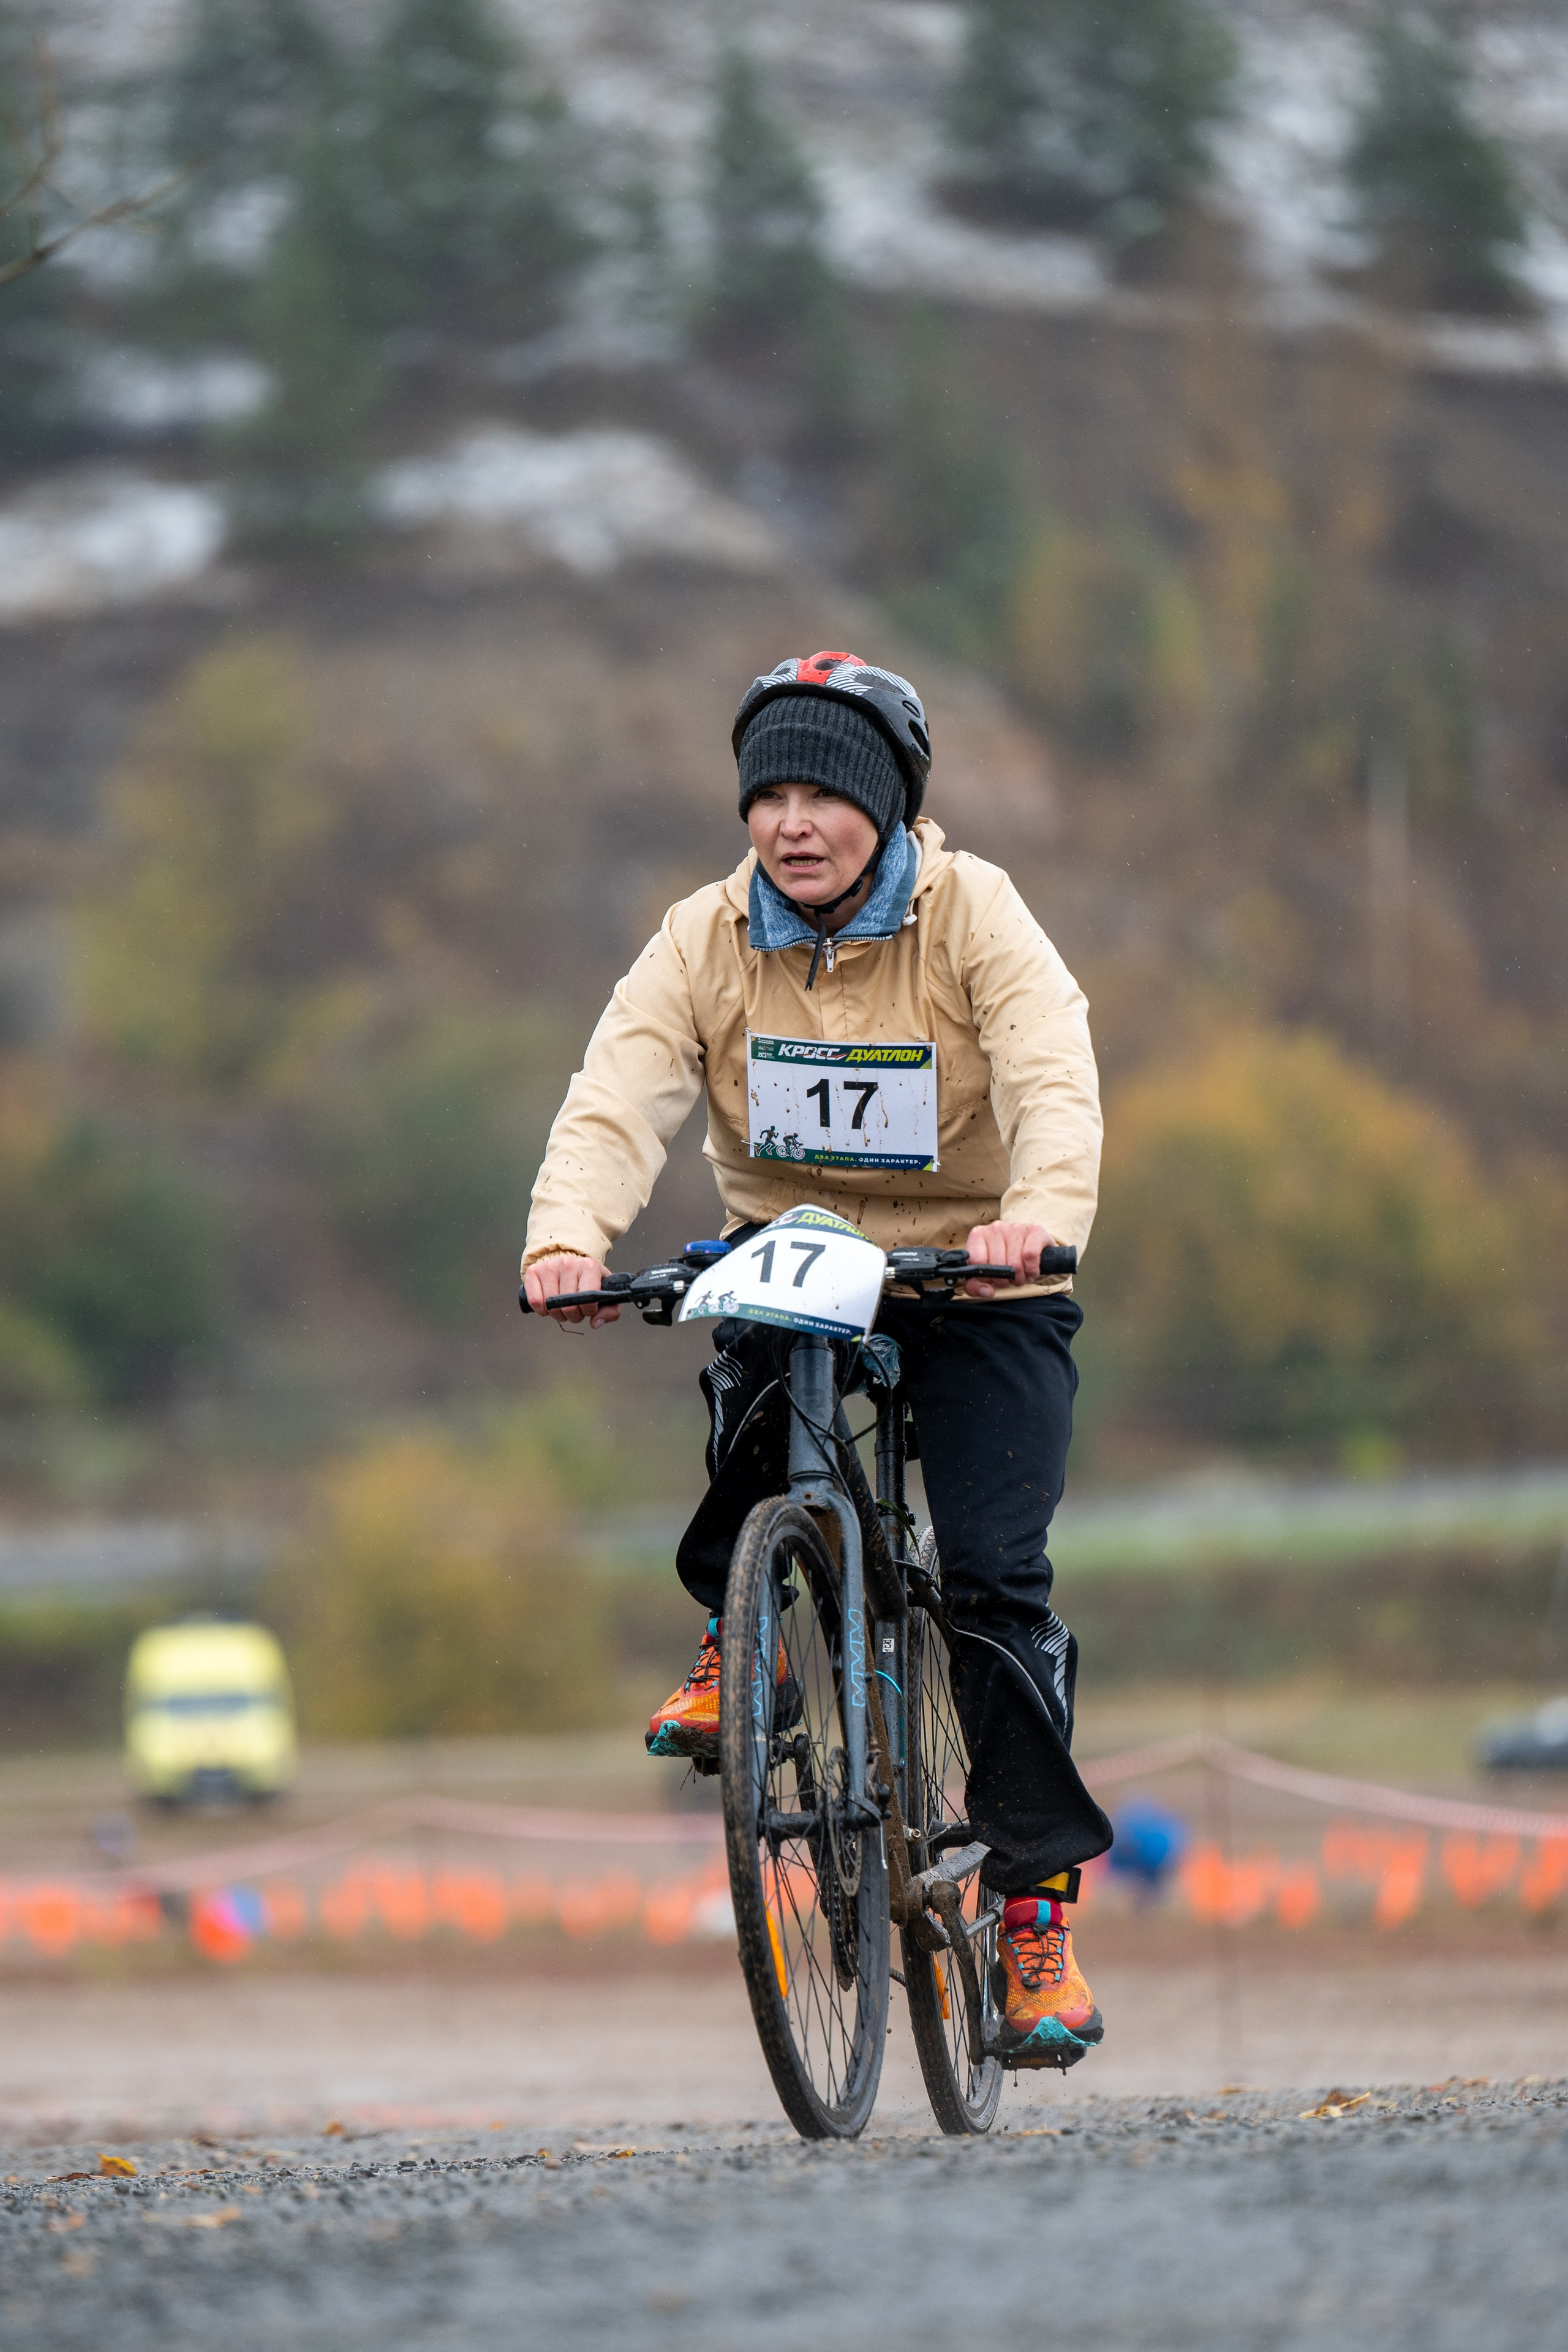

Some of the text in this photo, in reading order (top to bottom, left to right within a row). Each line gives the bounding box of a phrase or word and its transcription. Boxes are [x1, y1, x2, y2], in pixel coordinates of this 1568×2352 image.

[778, 1044, 845, 1060] КРОСС
[845, 1049, 924, 1063] ДУАТЛОН
[807, 1079, 878, 1129] 17
[751, 1240, 826, 1287] 17
[793, 1317, 814, 1326] ОДИН
[815, 1321, 853, 1335] ХАРАКТЕР.
